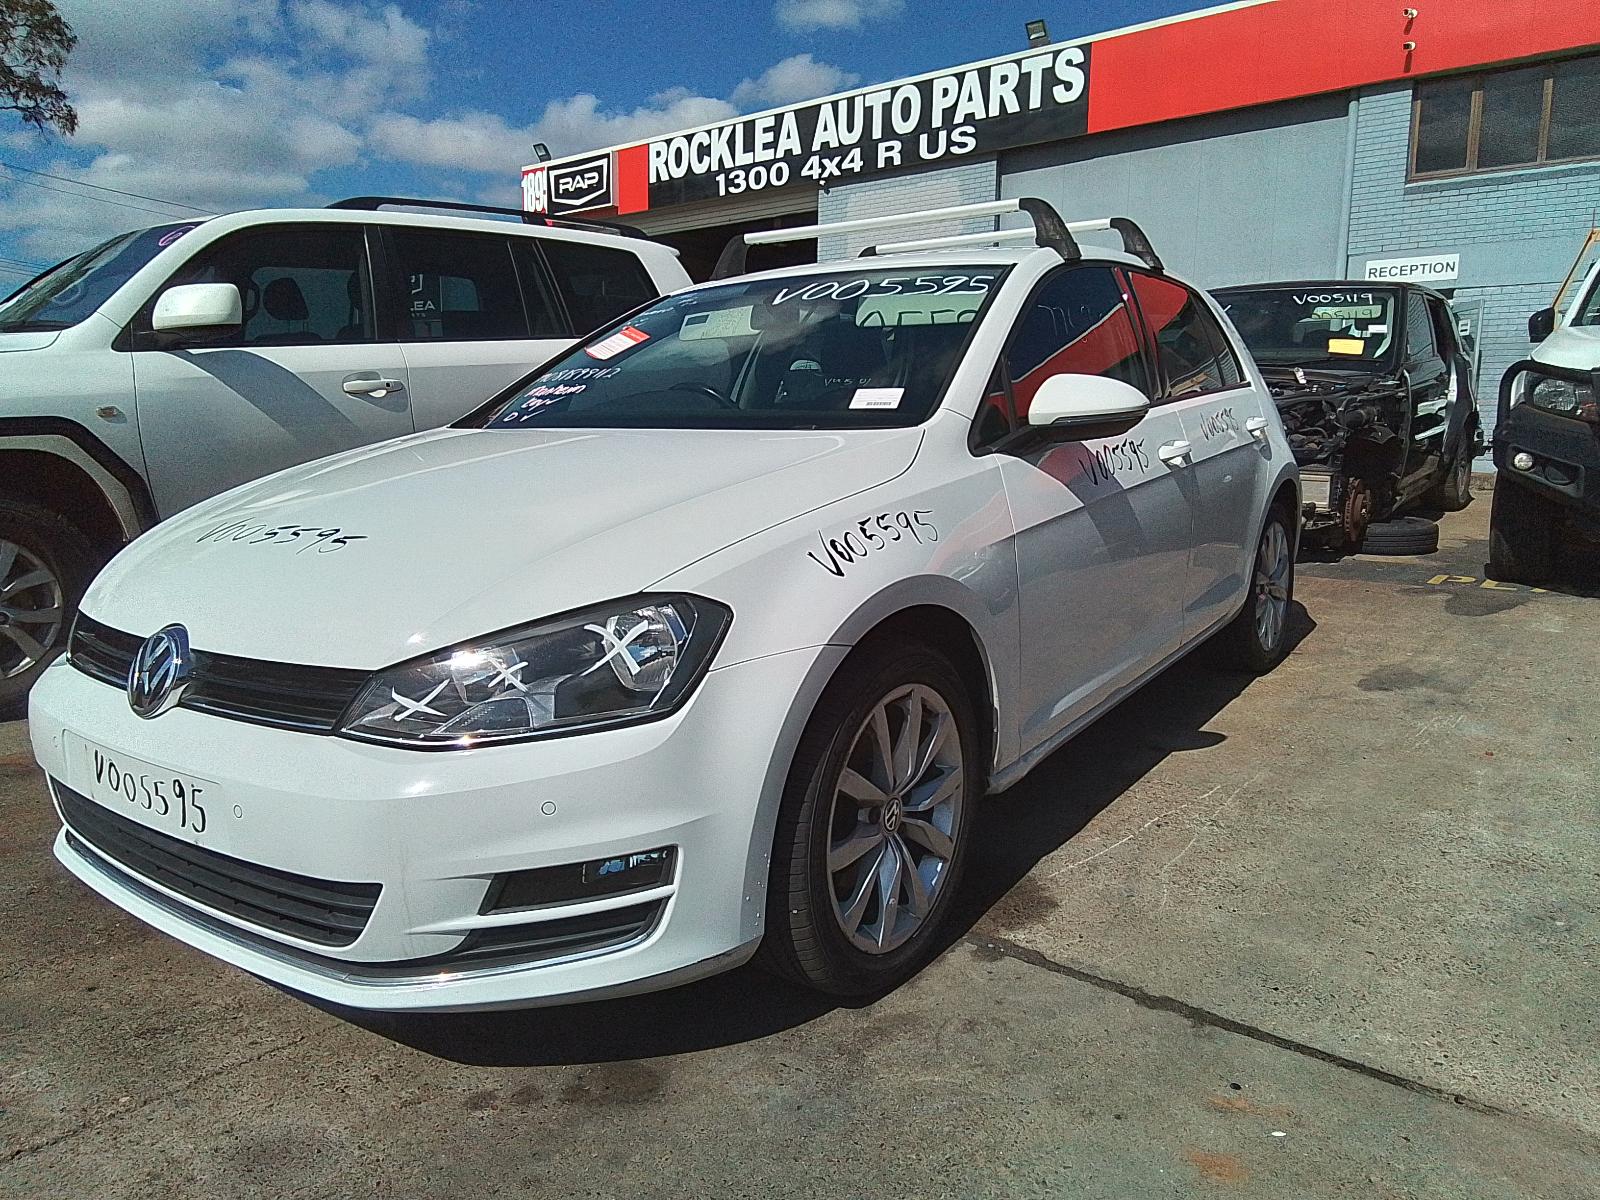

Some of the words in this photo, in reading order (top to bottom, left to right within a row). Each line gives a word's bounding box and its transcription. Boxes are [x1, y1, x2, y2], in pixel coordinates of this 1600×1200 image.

[648, 111, 802, 184] ROCKLEA
[811, 85, 922, 153] AUTO
[930, 47, 1087, 129] PARTS
[715, 160, 790, 197] 1300
[800, 148, 864, 181] 4x4
[876, 140, 902, 169] R
[918, 125, 978, 161] US
[772, 275, 996, 306] V005595
[1367, 261, 1456, 279] RECEPTION
[1292, 293, 1374, 306] V005119
[1077, 437, 1151, 486] V005595
[195, 516, 369, 556] V005595
[806, 510, 940, 578] V005595
[94, 749, 207, 834] V005595
